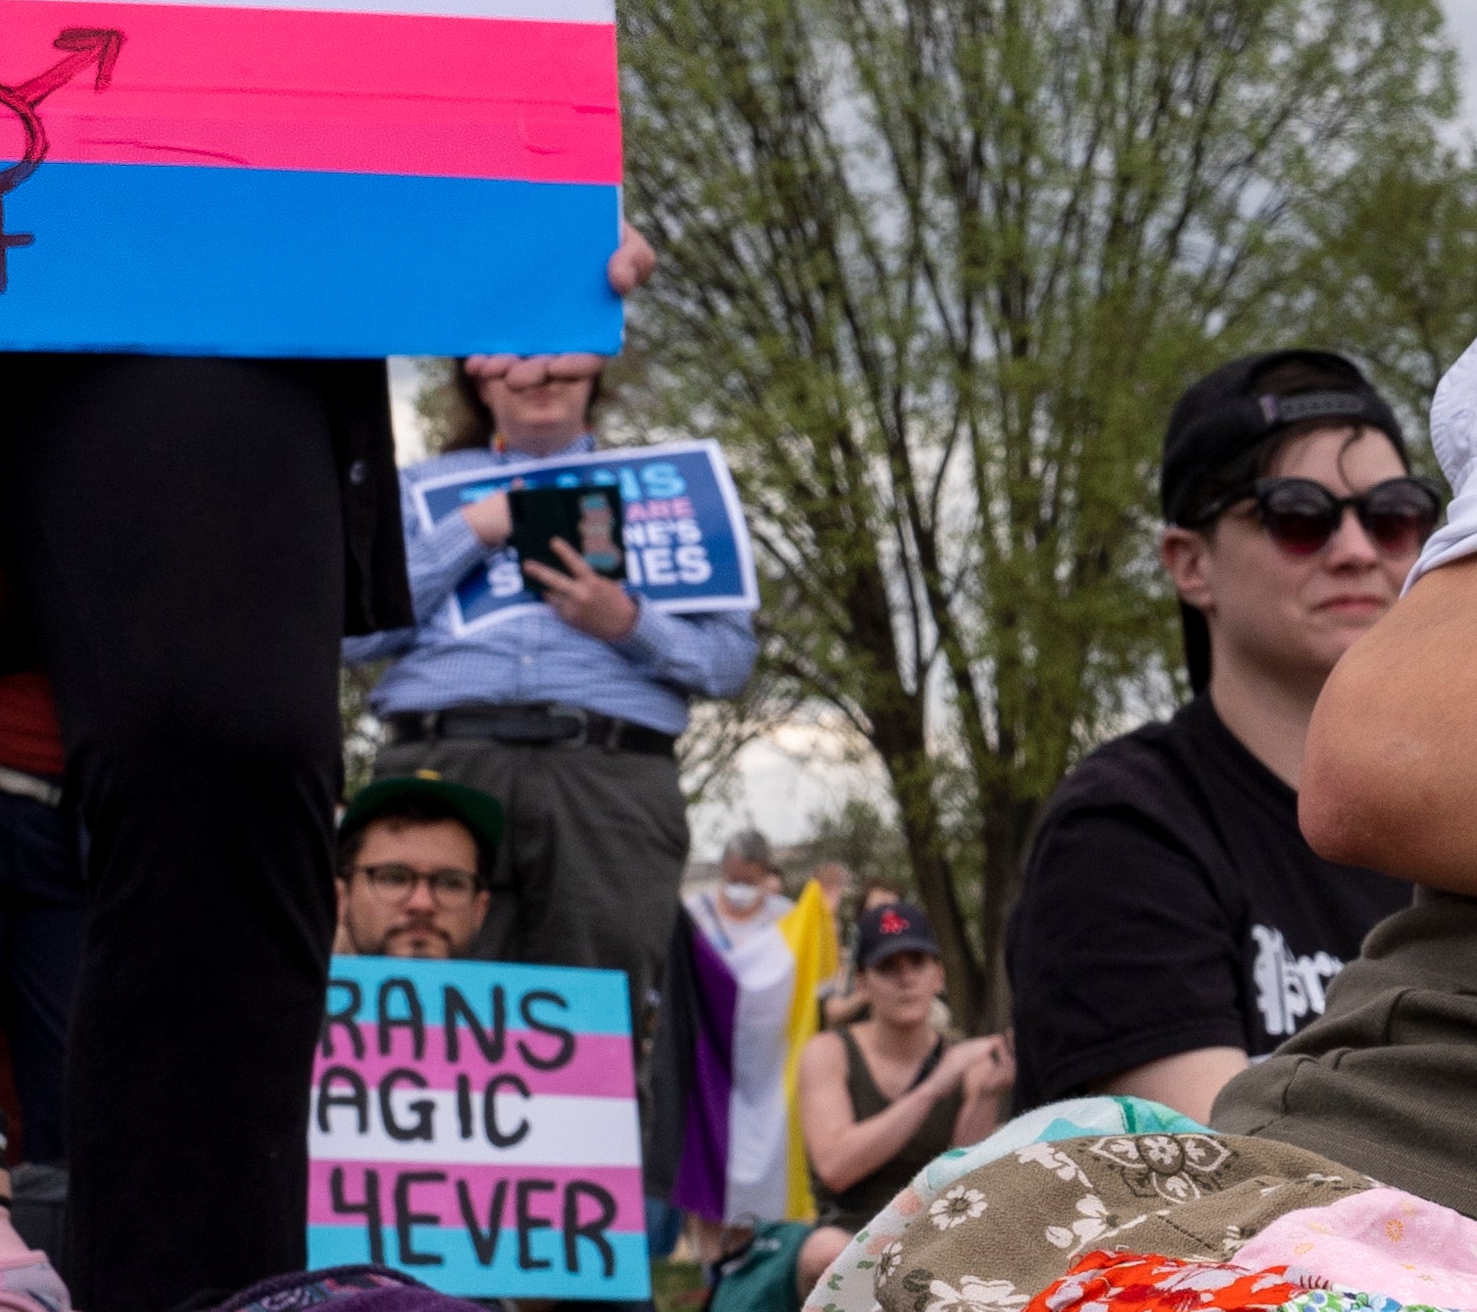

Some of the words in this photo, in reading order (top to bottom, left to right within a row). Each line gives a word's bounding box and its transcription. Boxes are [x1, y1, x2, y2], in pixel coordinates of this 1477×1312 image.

[323, 979, 575, 1070] RANS
[316, 1067, 532, 1148] AGIC
[330, 1168, 616, 1278] 4EVER
